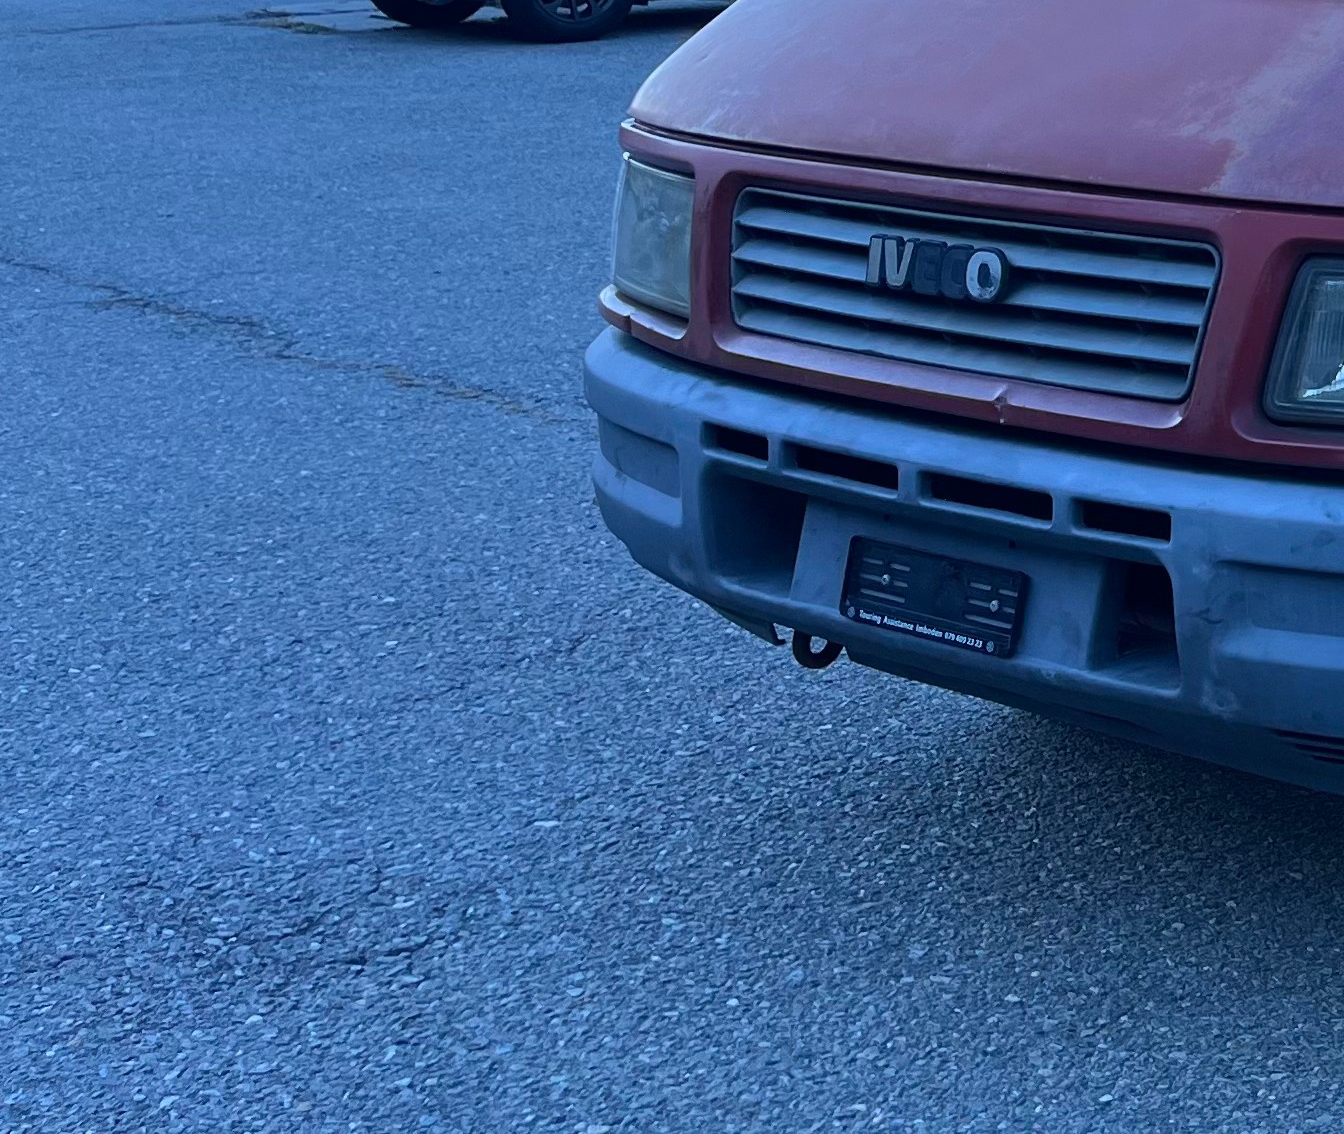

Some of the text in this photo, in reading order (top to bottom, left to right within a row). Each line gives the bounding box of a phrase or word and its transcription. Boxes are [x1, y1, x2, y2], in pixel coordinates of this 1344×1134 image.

[866, 237, 1002, 300] IVECO
[859, 609, 881, 624] Touring
[882, 615, 914, 631] Assistance
